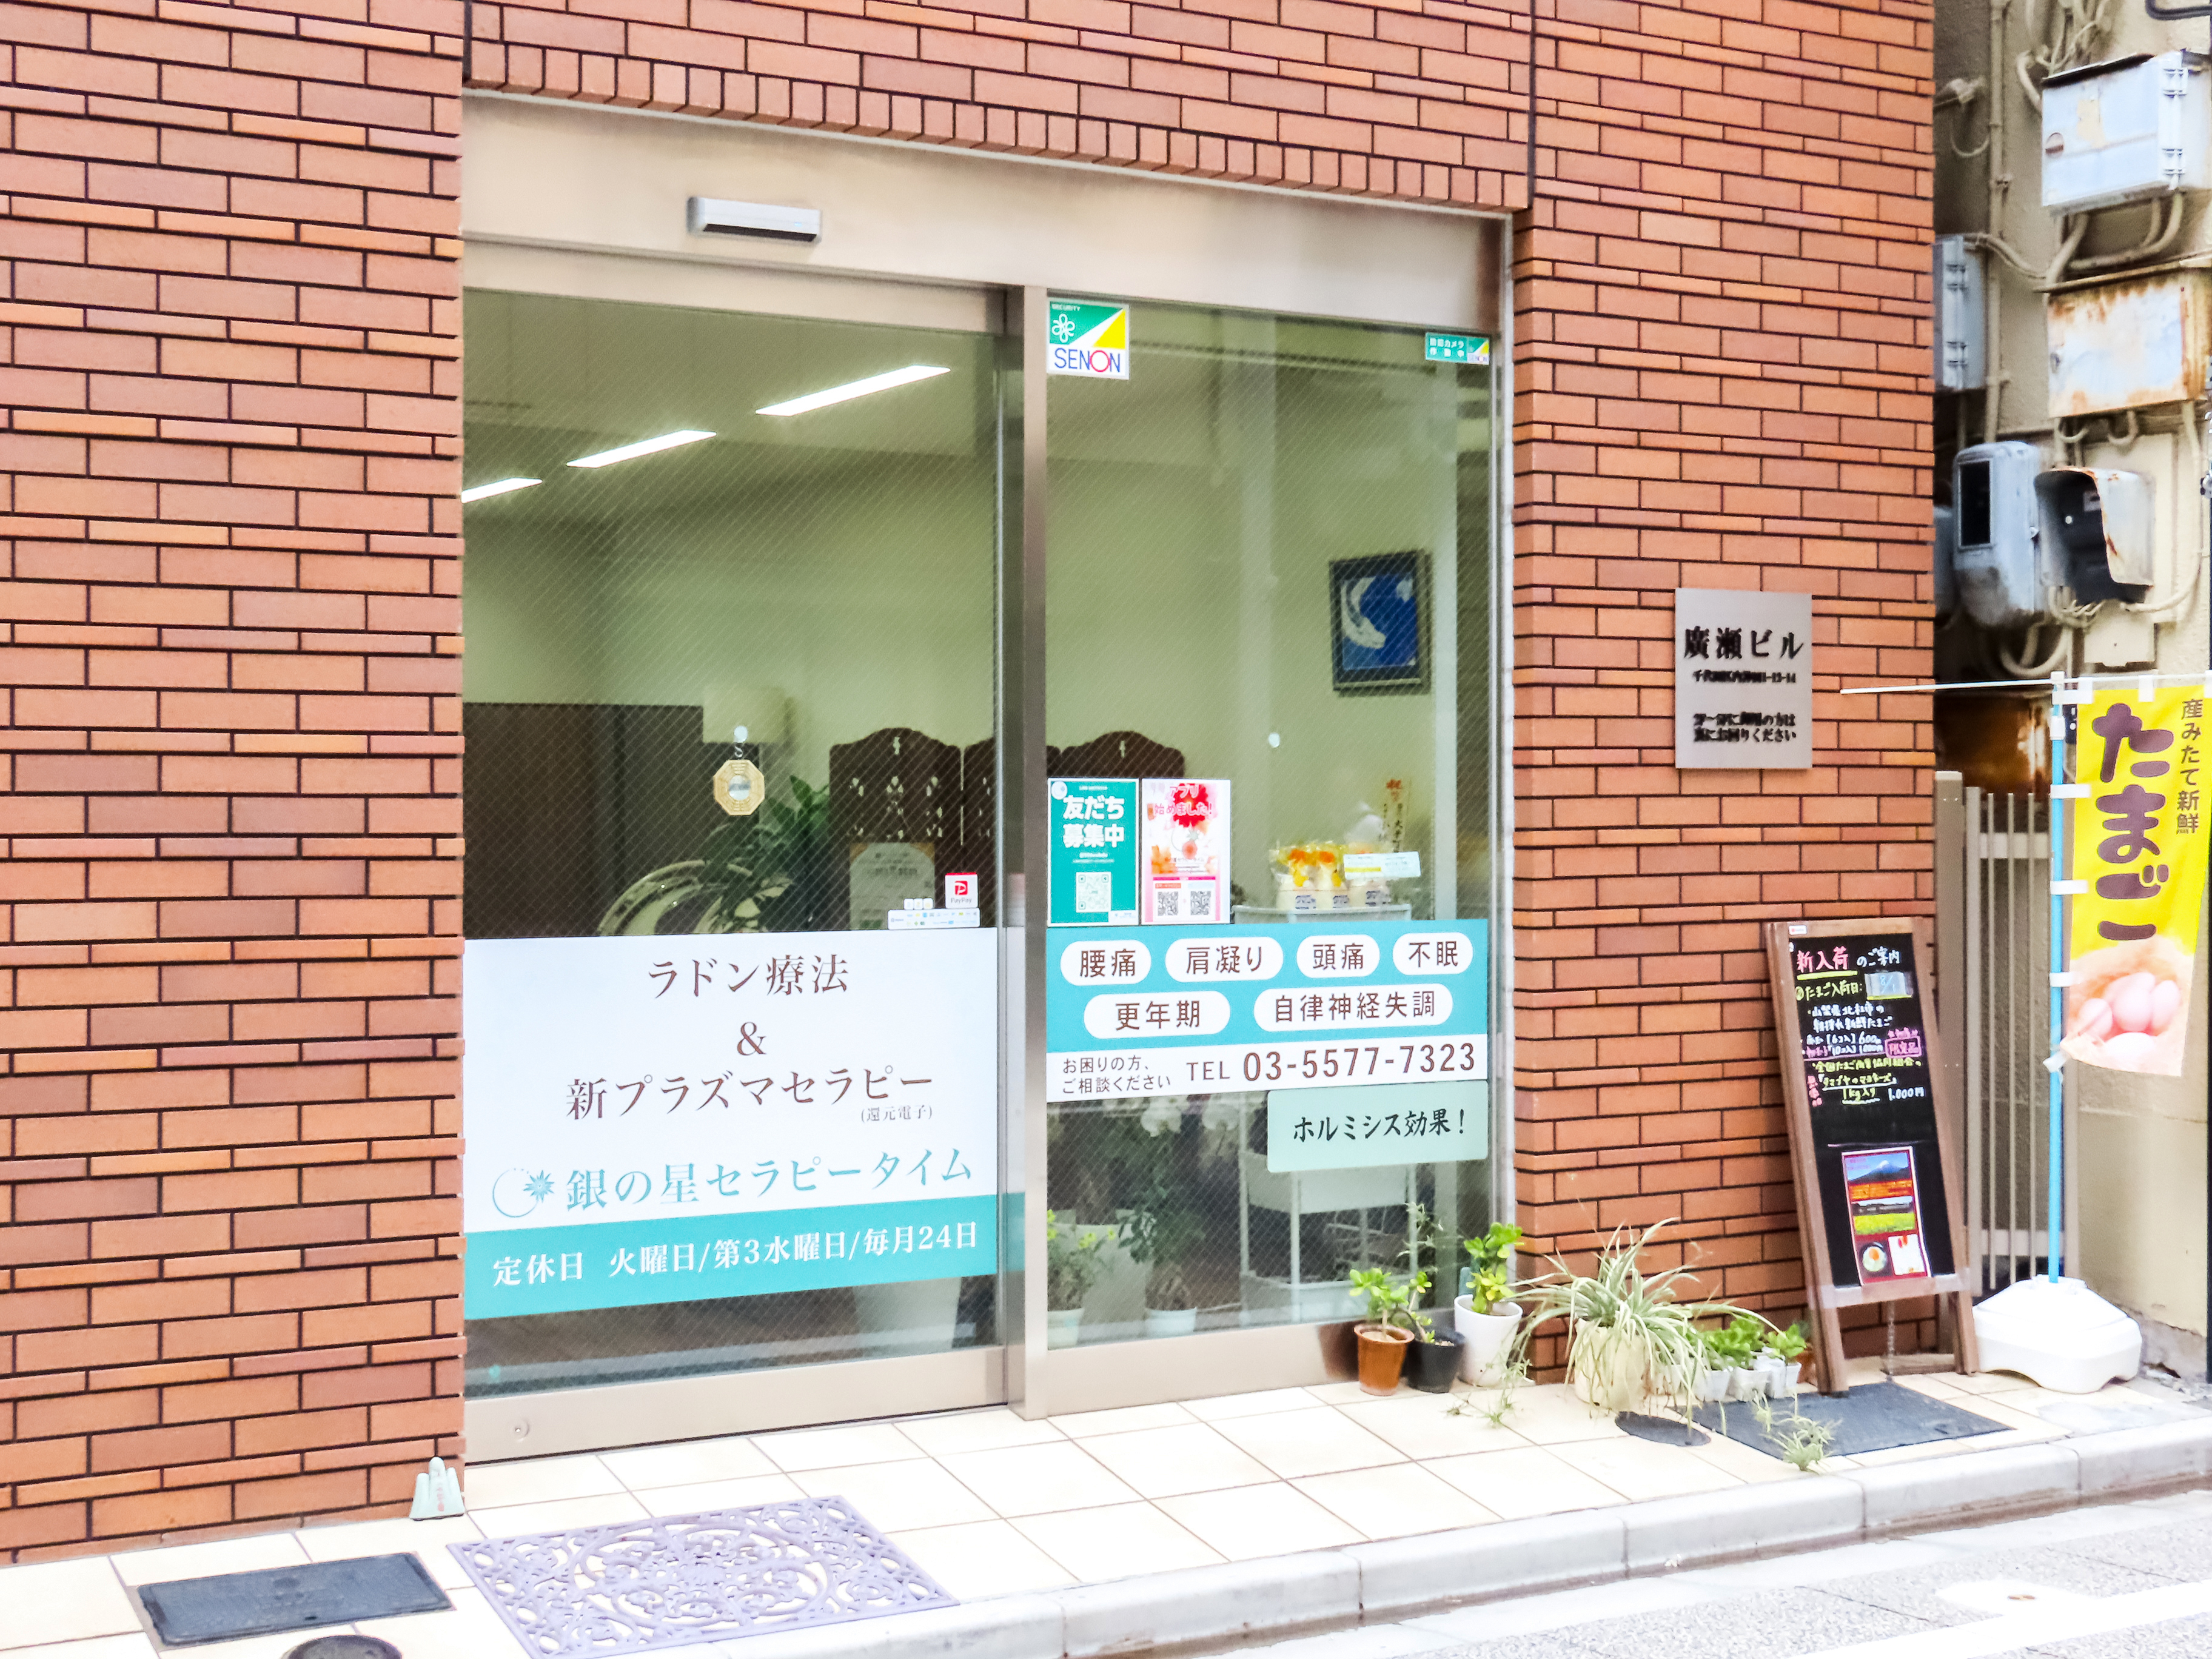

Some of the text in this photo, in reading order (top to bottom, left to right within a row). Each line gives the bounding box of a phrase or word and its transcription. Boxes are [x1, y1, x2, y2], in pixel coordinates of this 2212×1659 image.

[1054, 347, 1121, 373] SENON
[2176, 699, 2204, 835] 産みたて新鮮
[1062, 794, 1125, 820] 友だち
[2092, 702, 2174, 941] たまご
[1062, 823, 1125, 849] 募集中
[1079, 948, 1137, 978] 腰痛
[1185, 945, 1263, 975] 肩凝り
[1312, 942, 1366, 971] 頭痛
[1407, 940, 1460, 969] 不眠
[1797, 945, 1900, 973] 新入荷 のご案内
[648, 954, 850, 999] ラドン療法
[1114, 1000, 1201, 1031] 更年期
[1275, 990, 1436, 1024] 自律神経失調
[736, 1021, 767, 1057] &
[1186, 1042, 1476, 1082] TEL 03-5577-7323
[565, 1064, 933, 1121] 新プラズマセラピー
[1062, 1074, 1171, 1095] ご相談ください
[1292, 1108, 1466, 1144] ホルミシス効果!
[566, 1147, 973, 1212] 銀の星セラピータイム
[493, 1221, 978, 1288] 定休日 火曜日/第3水曜日/毎月24日
